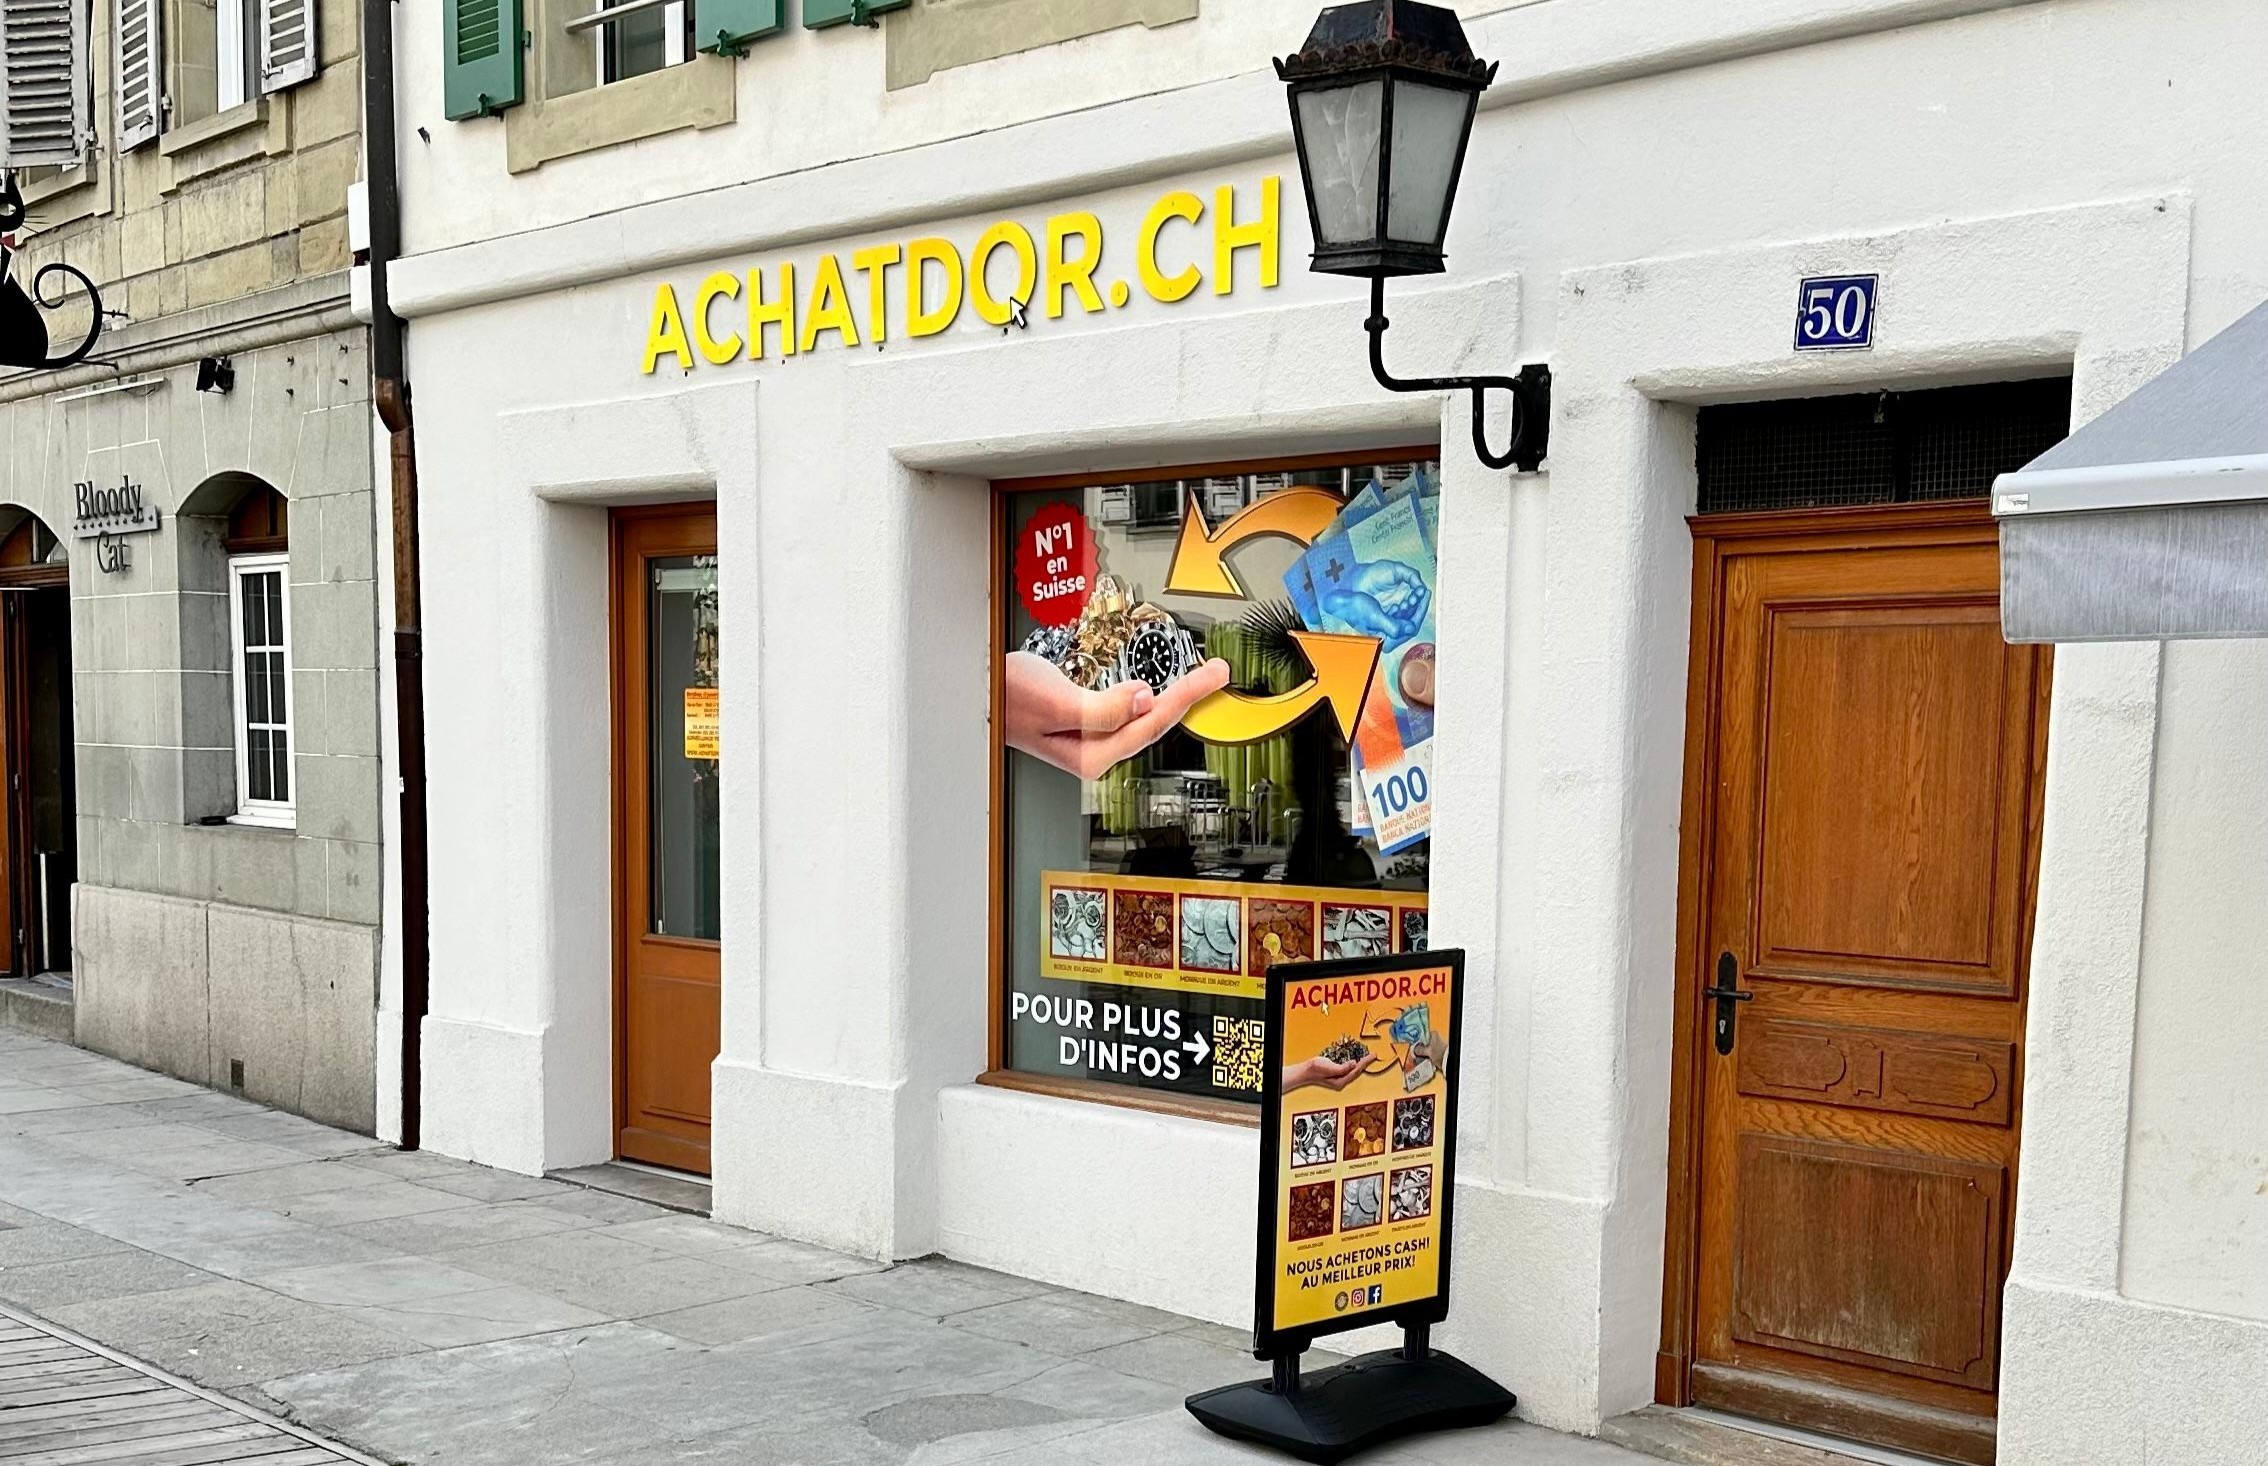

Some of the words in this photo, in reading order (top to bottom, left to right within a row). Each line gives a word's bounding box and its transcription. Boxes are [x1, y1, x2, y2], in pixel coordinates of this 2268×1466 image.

[640, 175, 1281, 374] ACHATDOR.CH
[1804, 286, 1867, 339] 50
[74, 475, 145, 523] Bloody
[96, 530, 132, 574] Cat
[1046, 556, 1068, 575] en
[1032, 575, 1086, 602] Suisse
[1372, 766, 1428, 818] 100
[1290, 972, 1447, 1010] ACHATDOR.CH
[1012, 991, 1094, 1030] POUR
[1103, 1002, 1181, 1041] PLUS
[1059, 1035, 1181, 1081] D'INFOS
[1286, 1258, 1323, 1276] NOUS
[1325, 1245, 1391, 1269] ACHETONS
[1300, 1275, 1319, 1290] AU
[1321, 1263, 1381, 1285] MEILLEUR
[1384, 1255, 1416, 1272] PRIX!
